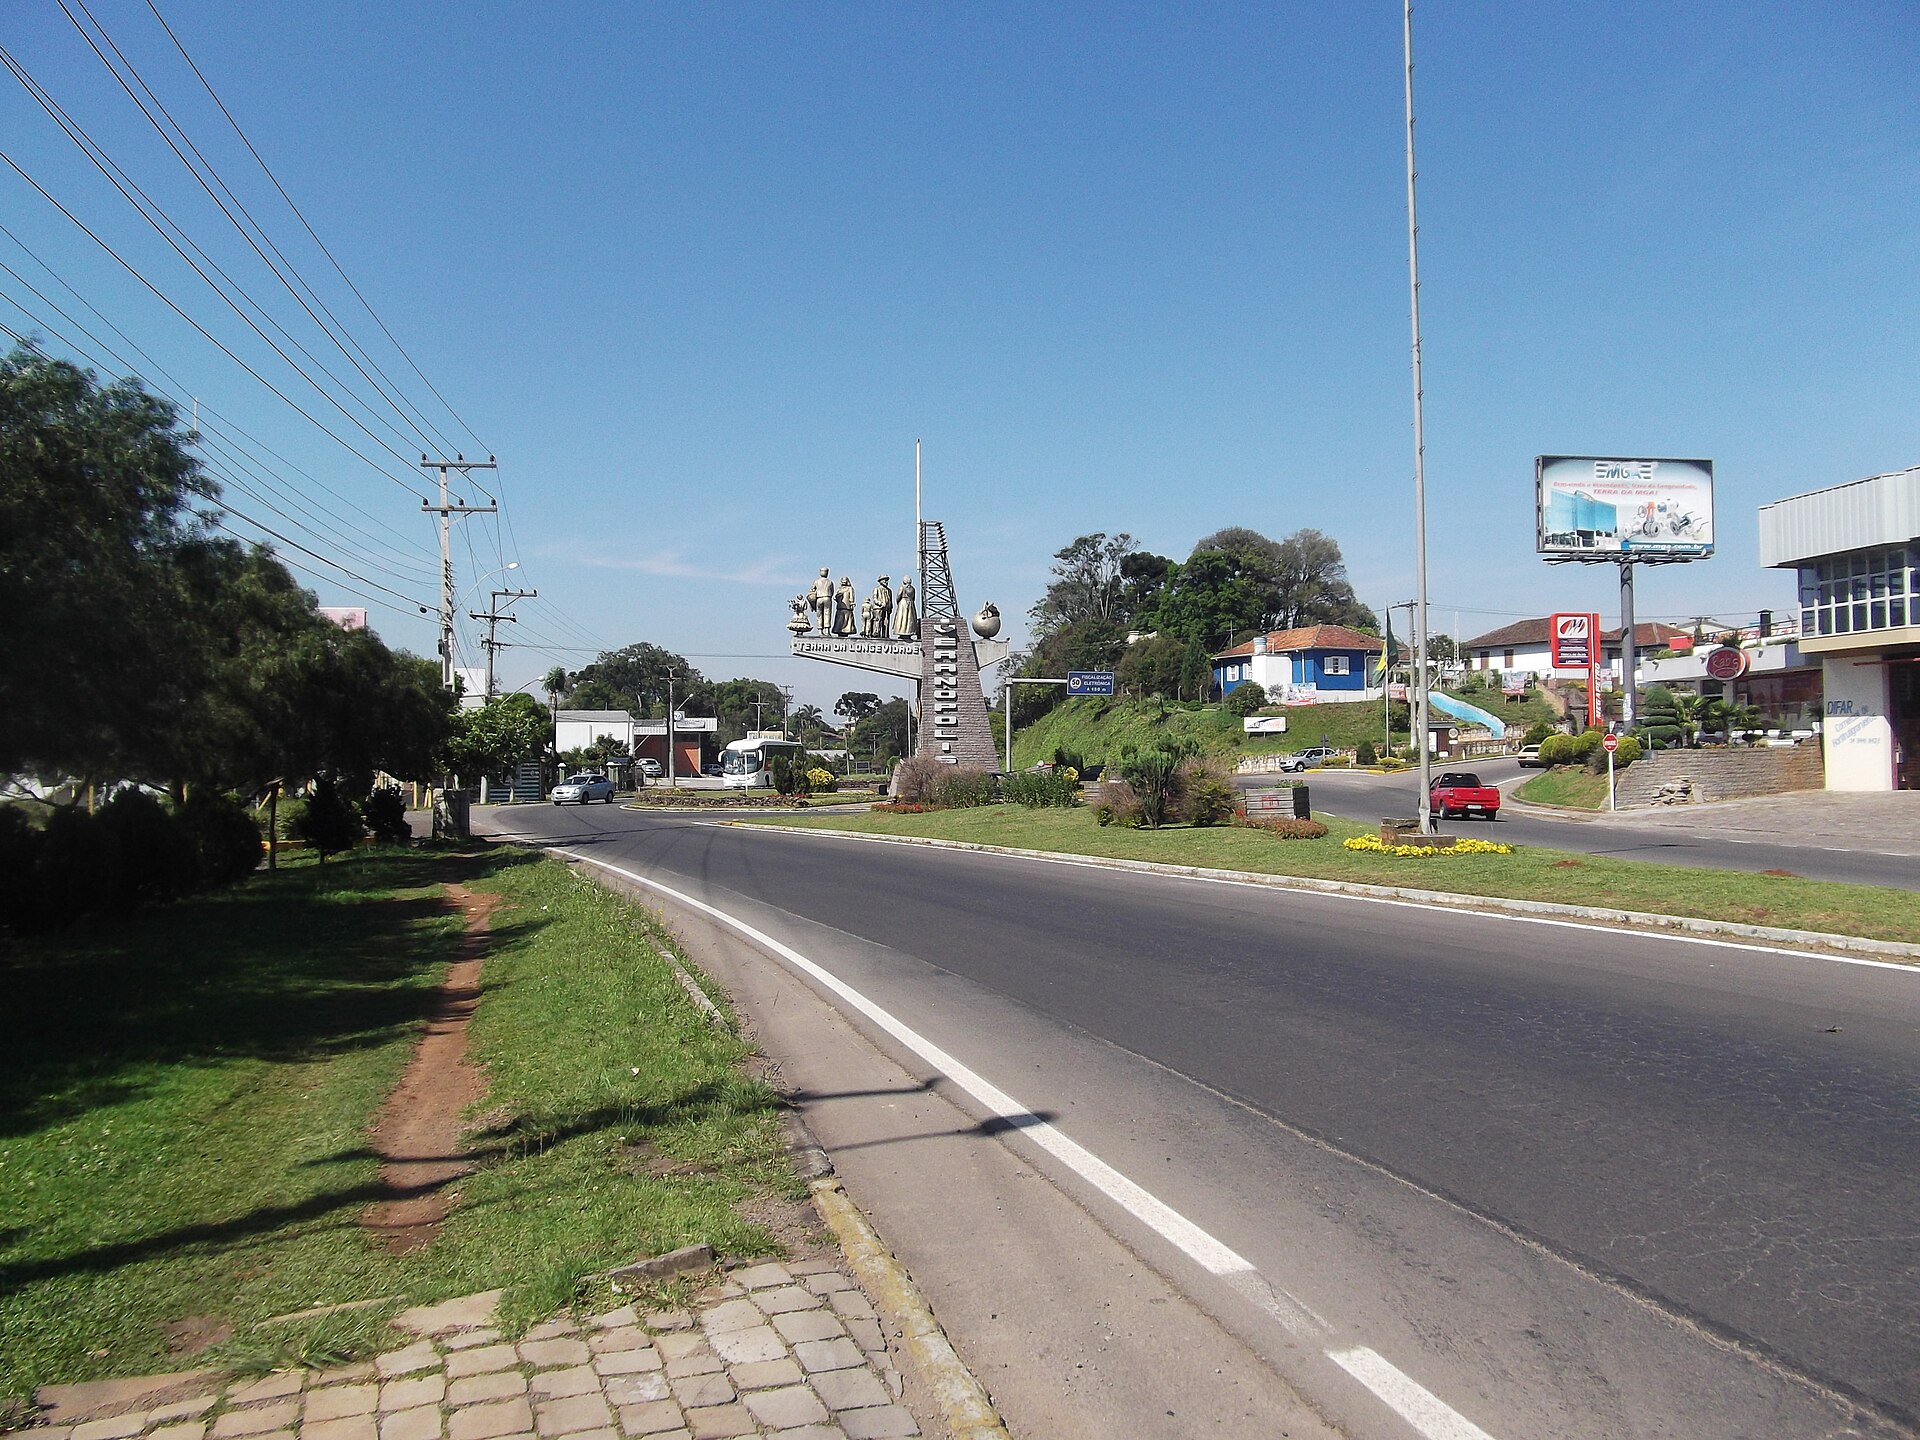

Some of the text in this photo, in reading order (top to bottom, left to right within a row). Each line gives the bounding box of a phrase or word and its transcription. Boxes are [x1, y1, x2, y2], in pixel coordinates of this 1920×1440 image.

[798, 643, 920, 655] TERRA DA LONGEVIDADE
[1827, 700, 1853, 715] DIFAR
